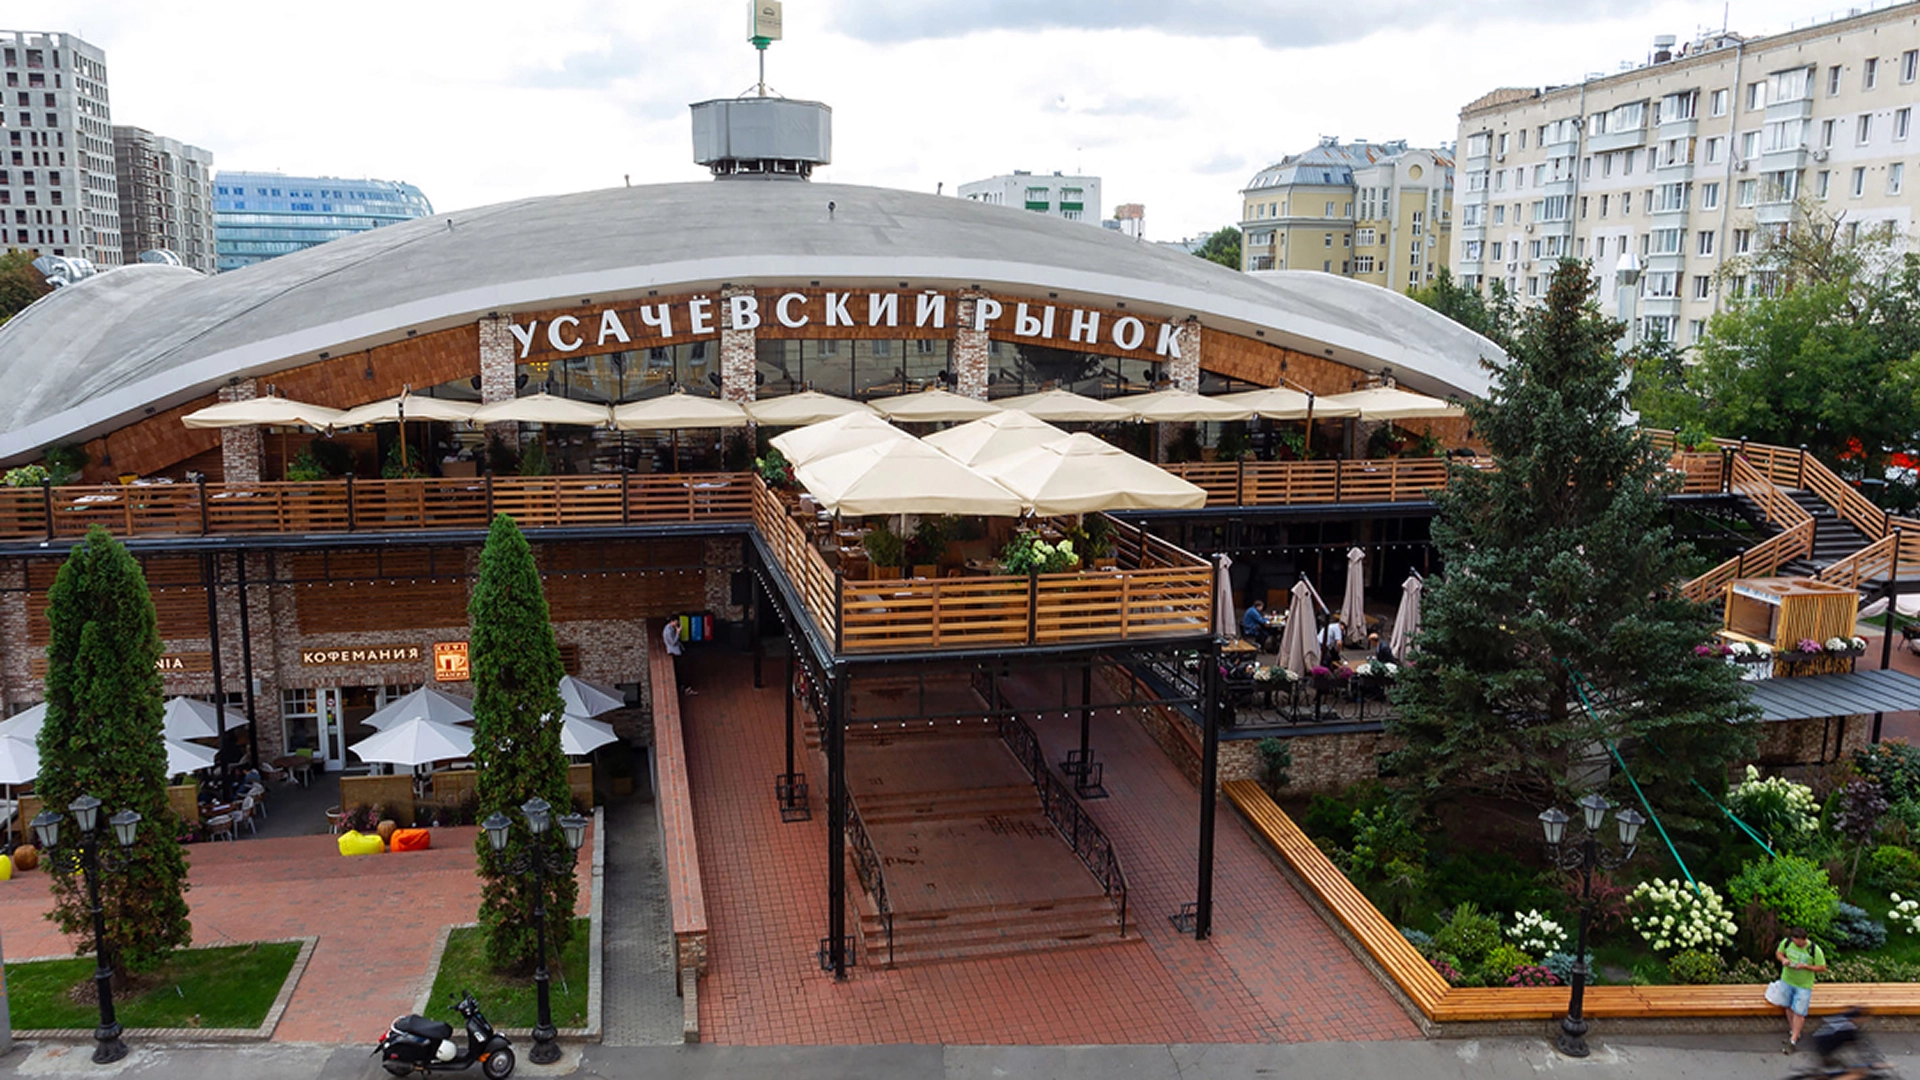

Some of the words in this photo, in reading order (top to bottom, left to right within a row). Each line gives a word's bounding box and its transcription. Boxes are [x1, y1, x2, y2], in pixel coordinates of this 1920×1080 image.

[508, 290, 946, 358] УСАЧЁВСКИЙ
[974, 298, 1184, 359] РЫНОК
[303, 648, 419, 663] КОФЕМАНИЯ
